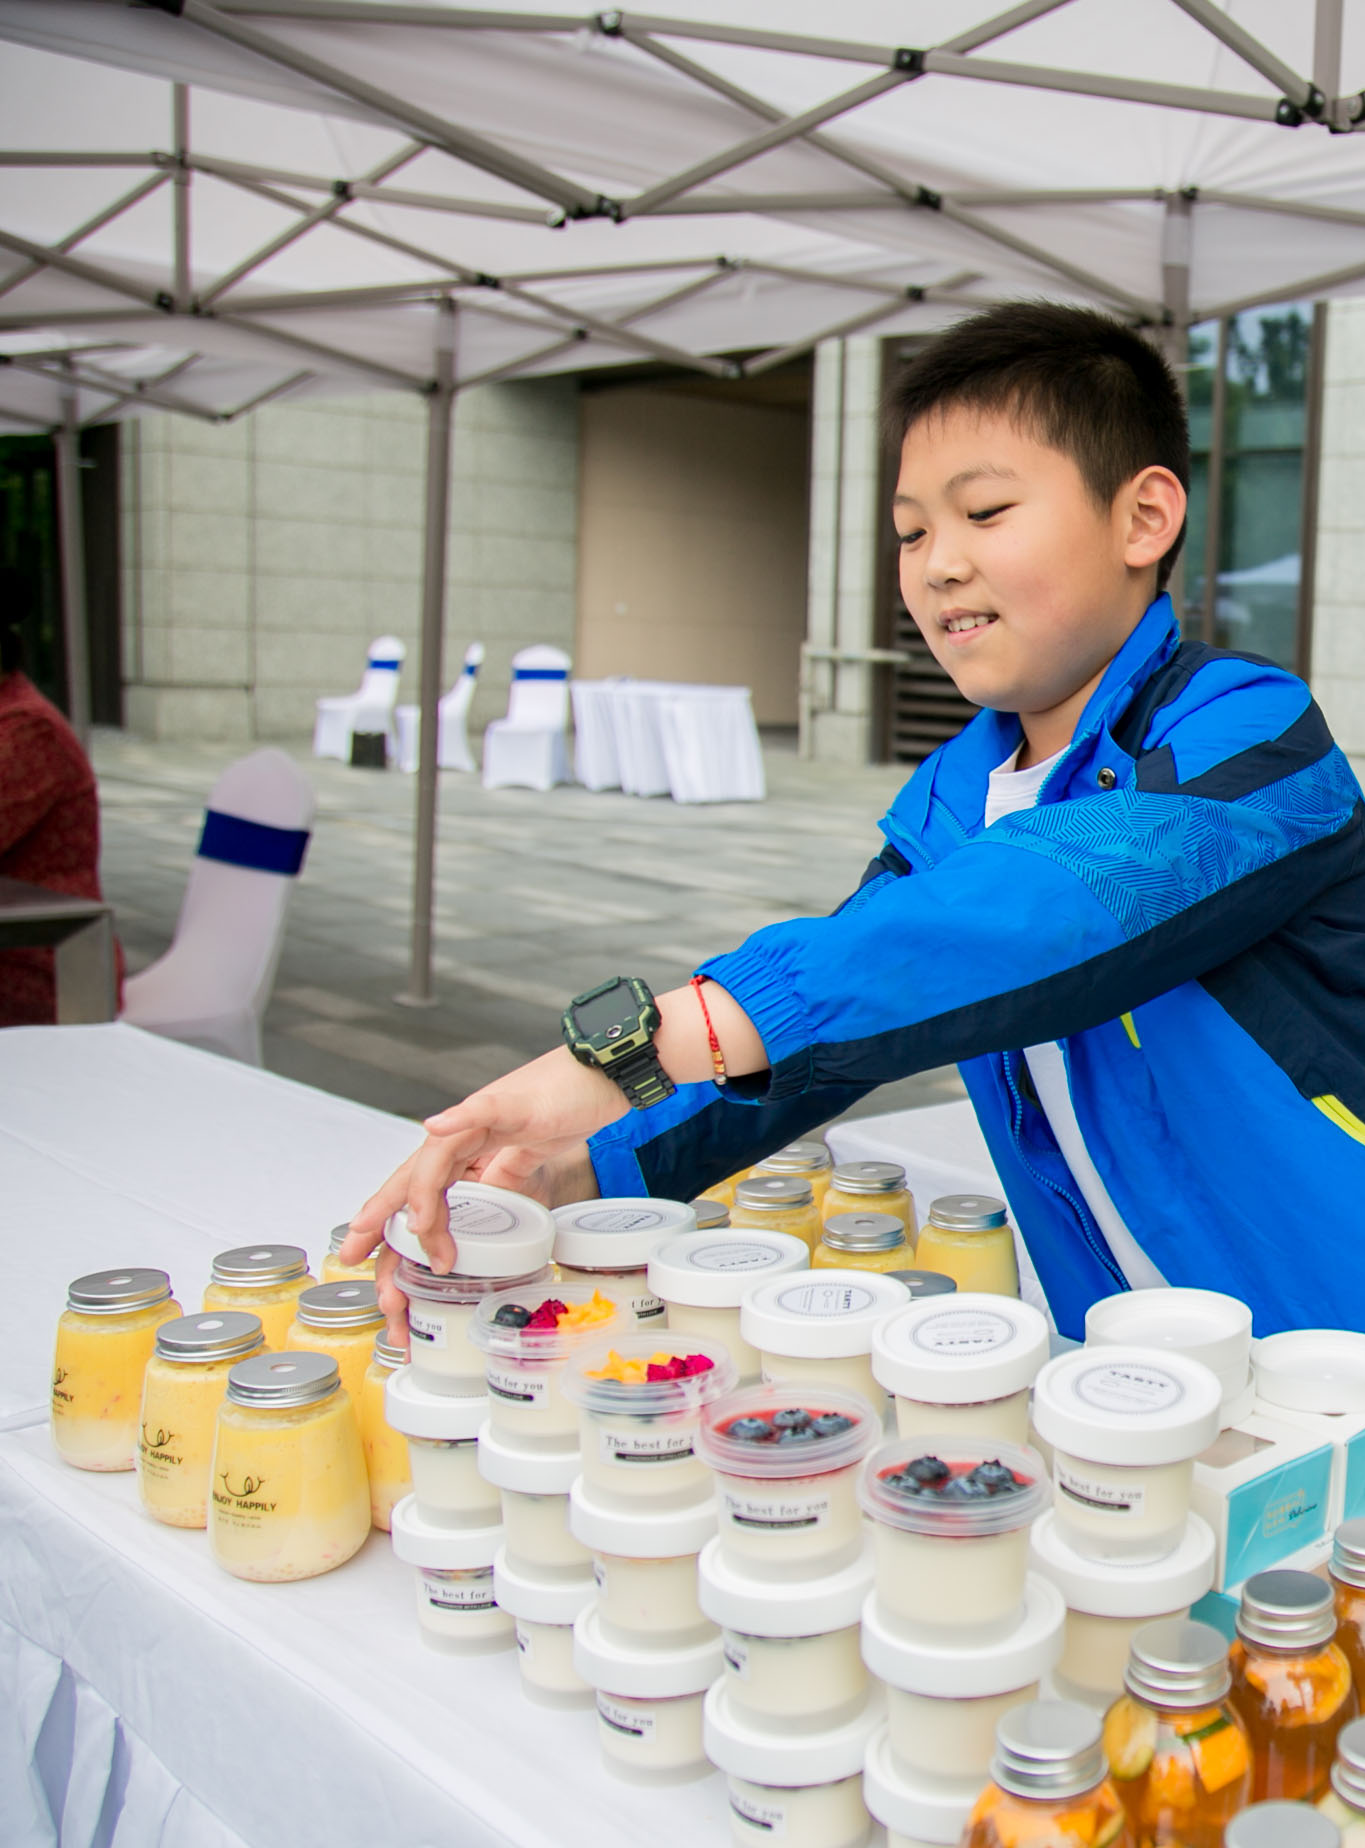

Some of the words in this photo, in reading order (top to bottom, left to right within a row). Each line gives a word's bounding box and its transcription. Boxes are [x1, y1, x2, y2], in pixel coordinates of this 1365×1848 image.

[503, 1376, 519, 1390] for
[523, 1382, 544, 1393] you
[605, 1434, 628, 1449] The
[633, 1439, 661, 1450] best
[666, 1436, 685, 1449] for
[150, 1449, 183, 1465] HAPPILY
[236, 1498, 277, 1513] HAPPILY
[442, 1589, 465, 1600] best
[469, 1590, 487, 1600] for
